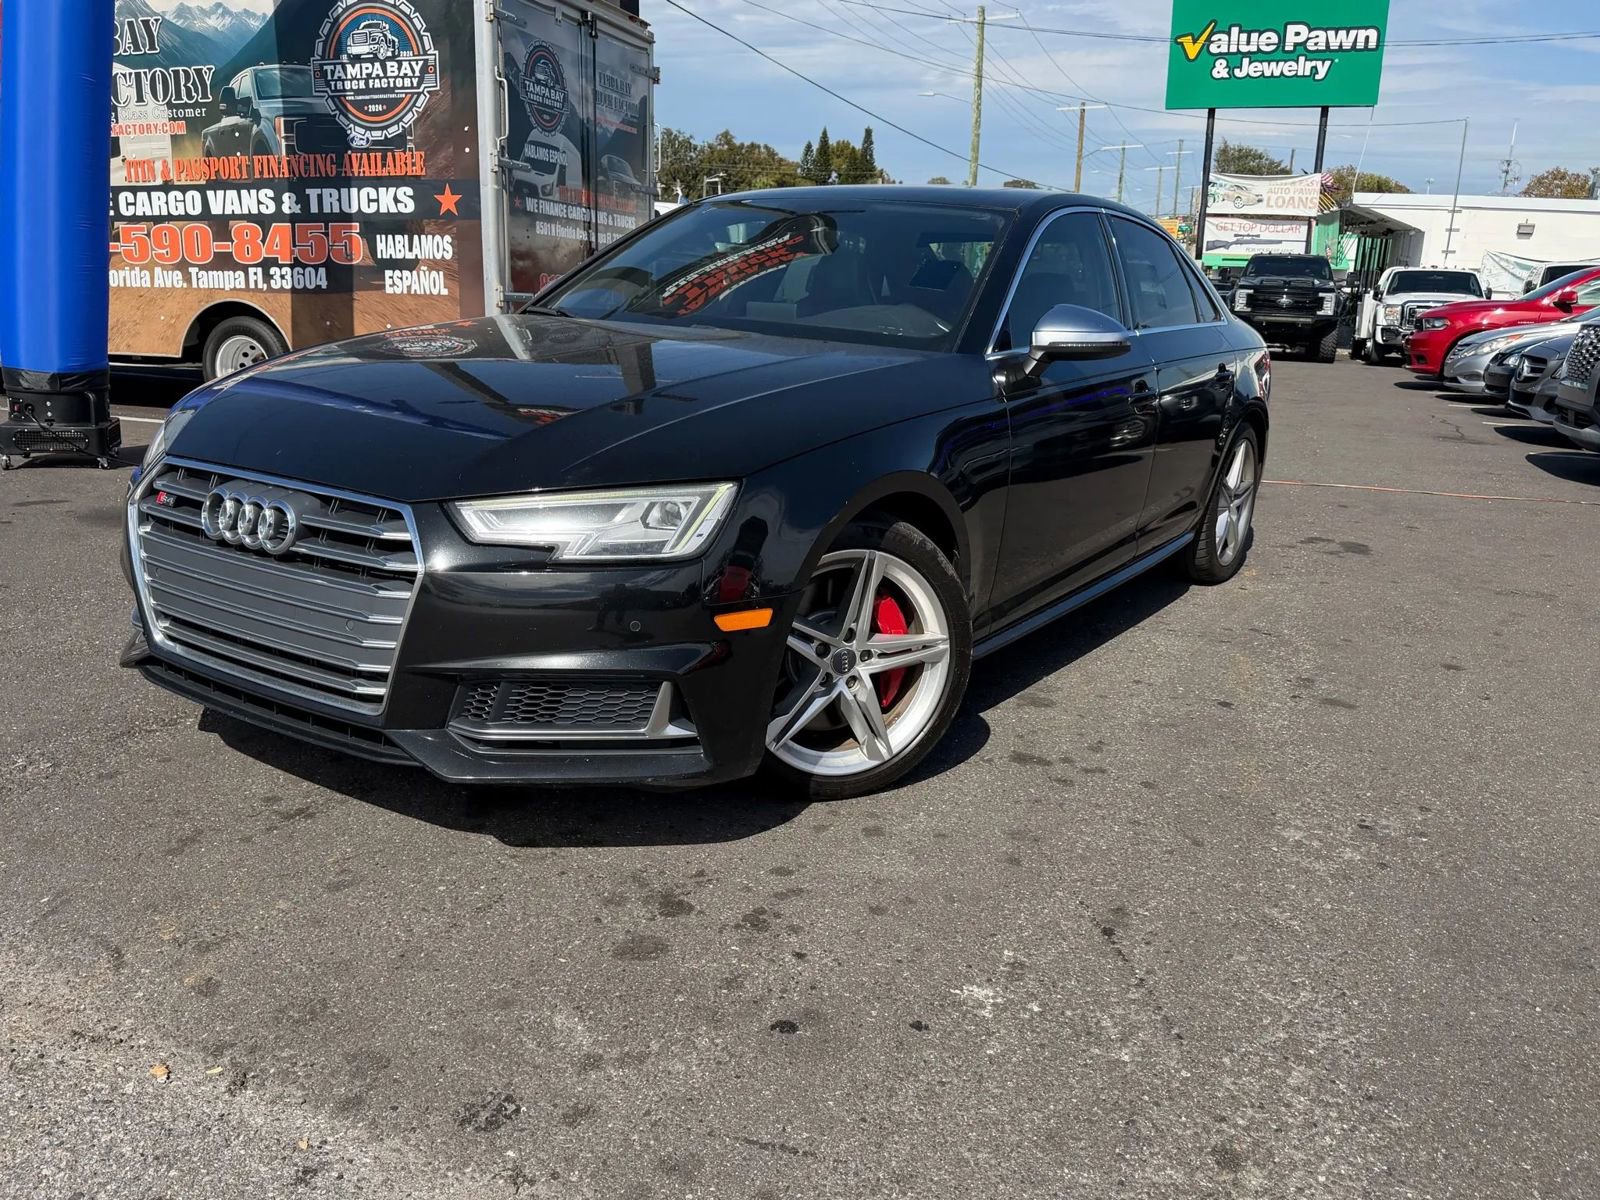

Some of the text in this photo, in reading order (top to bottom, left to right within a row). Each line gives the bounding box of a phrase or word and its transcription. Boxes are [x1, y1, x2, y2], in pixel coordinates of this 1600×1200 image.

[1284, 24, 1379, 51] Pawn
[323, 60, 425, 80] TAMPA BAY
[1211, 56, 1332, 80] & Jewelry
[330, 78, 419, 91] TRUCK FACTORY
[524, 81, 565, 102] TAMPA BAY
[152, 106, 207, 119] Customer
[160, 158, 173, 182] &
[173, 155, 249, 182] PASSPORT
[253, 152, 337, 180] FINANCING
[342, 150, 427, 177] AVAILABLE
[118, 190, 202, 216] CARGO
[206, 188, 276, 215] VANS
[281, 192, 302, 214] &
[305, 186, 415, 214] TRUCKS
[525, 196, 539, 213] WE
[539, 199, 567, 218] FINANCE
[613, 213, 636, 230] TRUCKS
[1266, 196, 1318, 209] LOANS
[1216, 222, 1302, 234] GET TOP DOLLAR
[376, 234, 453, 260] HABLAMOS
[154, 267, 187, 288] Ave.
[188, 267, 246, 291] Tampa
[269, 266, 328, 289] 33604
[384, 266, 449, 296] ESPAÑOL
